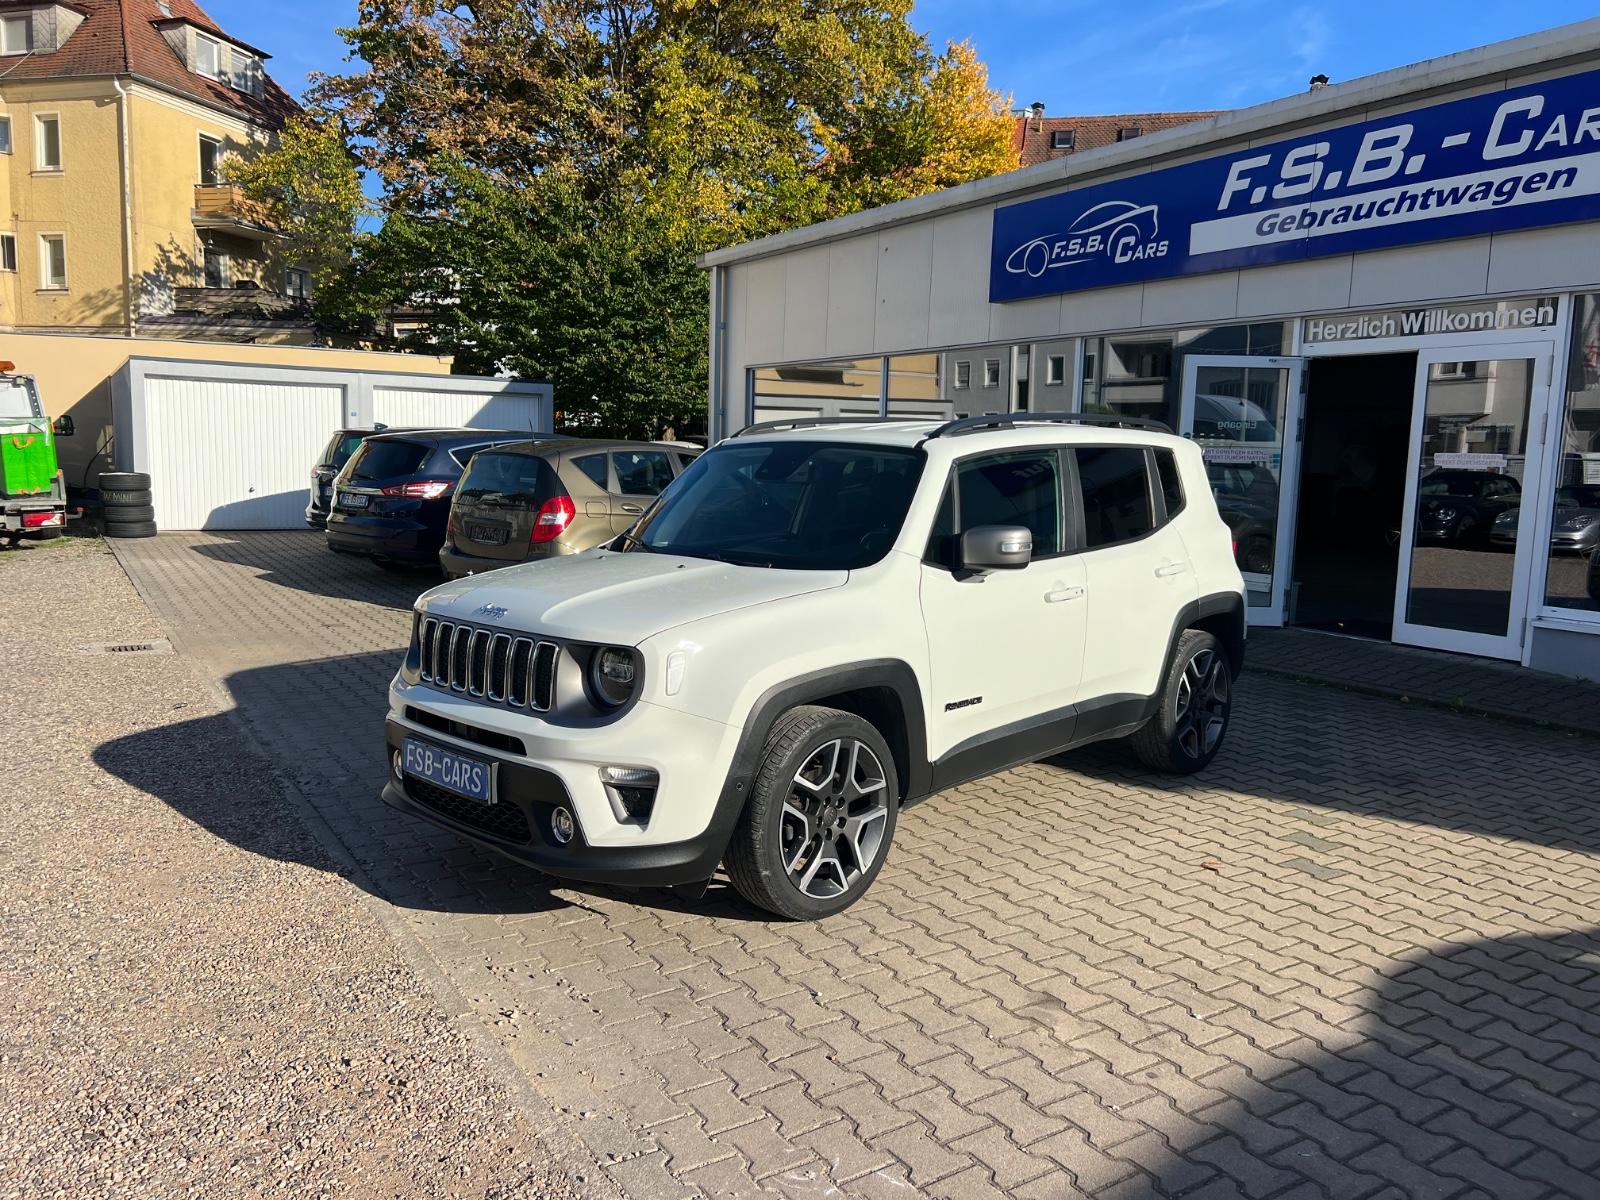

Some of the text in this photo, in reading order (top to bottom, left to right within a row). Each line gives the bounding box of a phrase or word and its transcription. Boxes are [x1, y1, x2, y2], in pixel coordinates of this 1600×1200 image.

[1255, 167, 1578, 237] Gebrauchtwagen
[1052, 235, 1169, 264] F.S.B. CARS
[1307, 304, 1554, 342] Herzlich Willkommen
[406, 744, 482, 793] FSB-CARS
